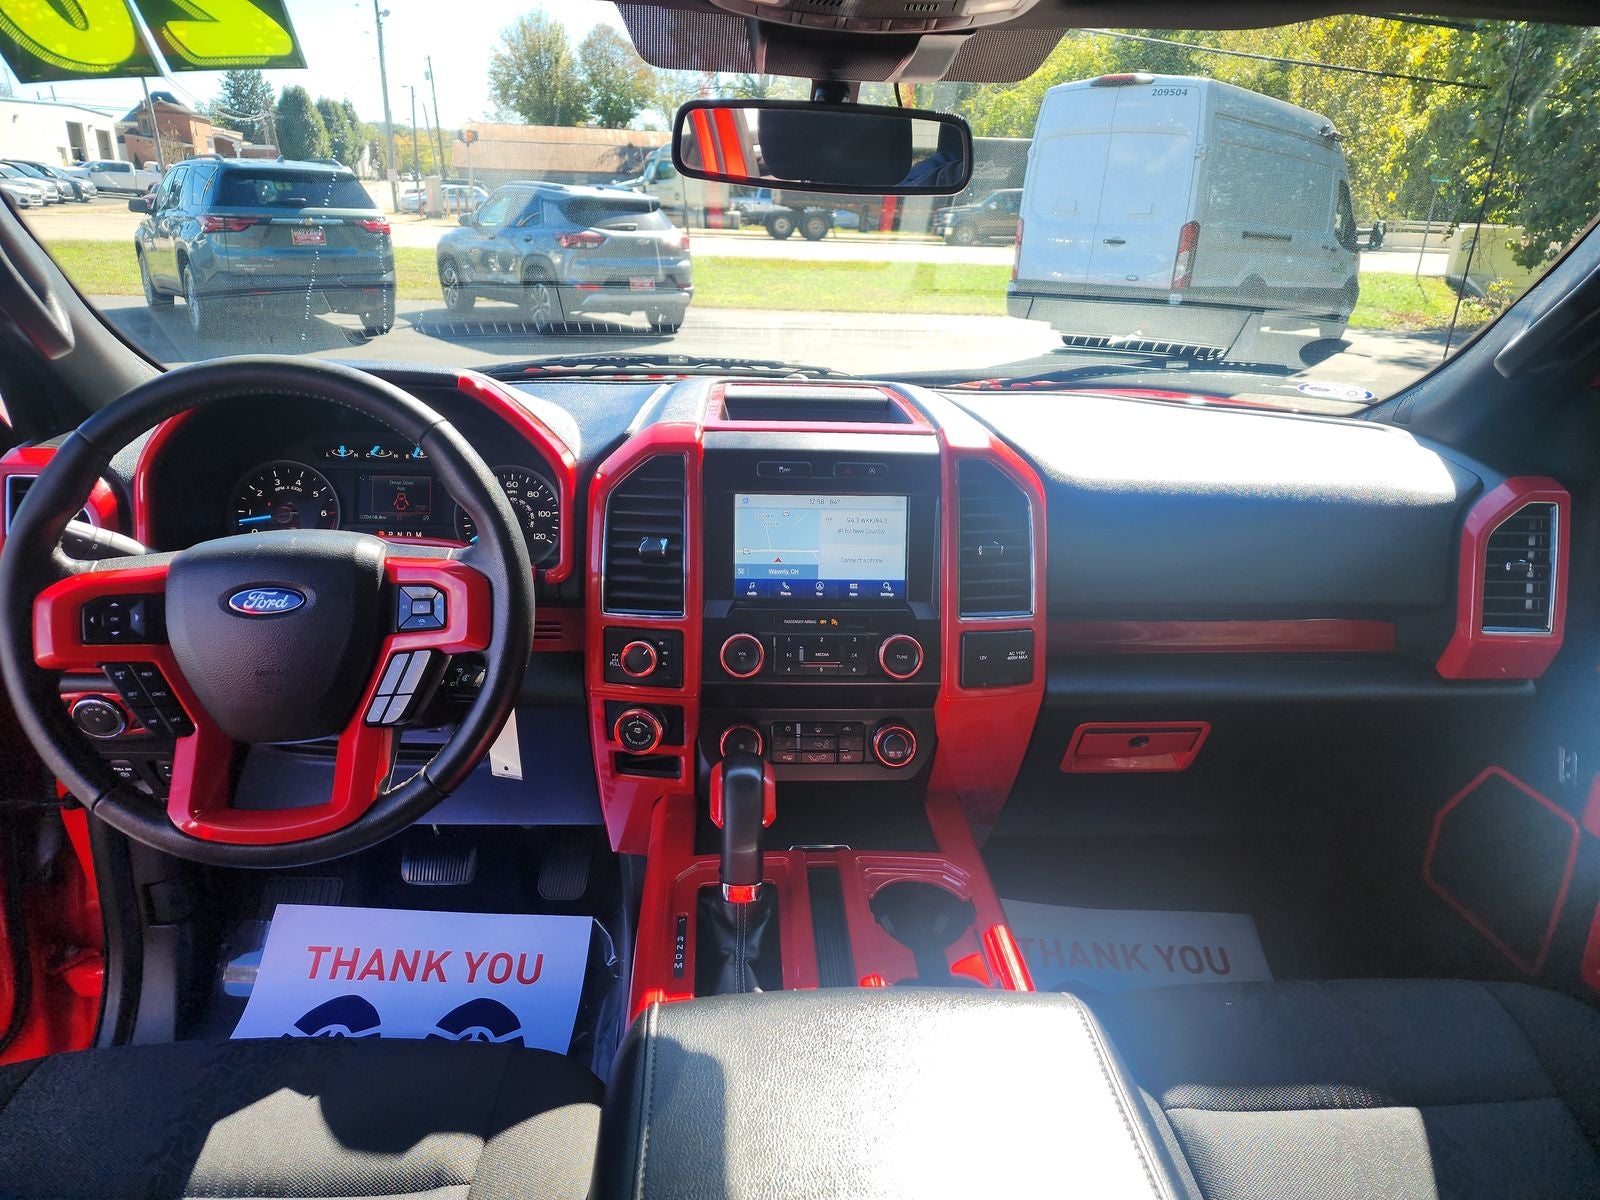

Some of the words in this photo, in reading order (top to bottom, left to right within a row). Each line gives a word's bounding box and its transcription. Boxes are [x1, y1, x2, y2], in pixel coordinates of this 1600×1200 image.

[1151, 88, 1188, 97] 209504
[312, 490, 320, 498] 5
[538, 510, 551, 518] 100
[243, 591, 289, 609] Ford
[1016, 936, 1150, 972] THANK
[1152, 943, 1232, 976] YOU
[306, 945, 453, 984] THANK
[463, 951, 545, 986] YOU
